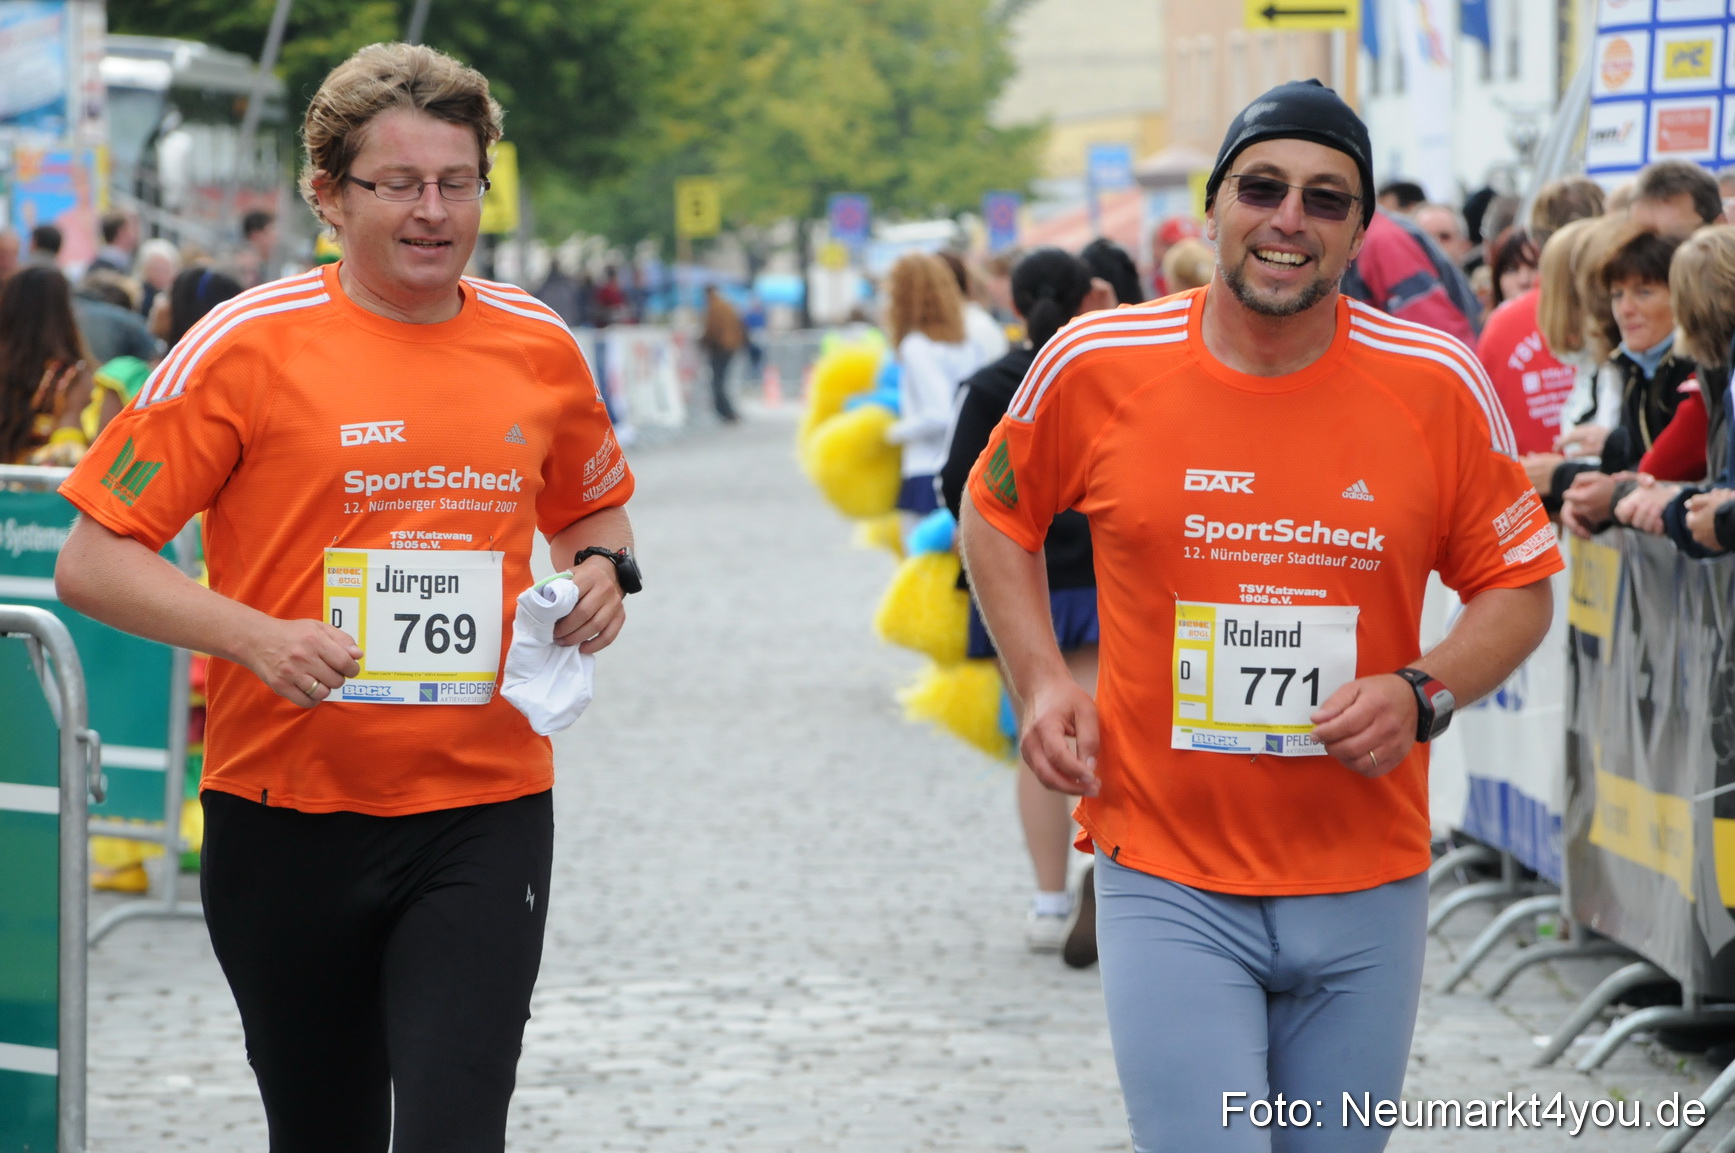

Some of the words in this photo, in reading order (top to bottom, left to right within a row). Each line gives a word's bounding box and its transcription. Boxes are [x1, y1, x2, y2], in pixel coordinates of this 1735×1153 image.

[340, 420, 407, 447] DAK
[504, 435, 527, 445] adidas
[344, 465, 523, 497] SportScheck
[1184, 469, 1255, 494] DAK
[1342, 490, 1374, 502] adidas
[343, 502, 364, 514] 12.
[369, 499, 436, 513] Nürnberger
[440, 498, 493, 512] Stadtlauf
[495, 501, 518, 513] 2007
[390, 531, 416, 540] TSV
[417, 531, 473, 542] Katzwang
[1184, 514, 1385, 552] SportScheck
[390, 541, 420, 549] 1905
[420, 541, 441, 550] e.V.
[1183, 546, 1205, 559] 12.
[1211, 548, 1284, 566] Nürnberger
[1287, 552, 1348, 567] Stadtlauf
[1350, 557, 1381, 571] 2007
[376, 565, 459, 599] Jürgen
[1239, 584, 1265, 594] TSV
[1266, 585, 1327, 598] Katzwang
[1240, 594, 1270, 604] 1905
[1272, 595, 1293, 605] e.V.
[332, 609, 342, 628] D
[394, 613, 476, 654] 769
[1224, 619, 1301, 648] Roland
[1181, 661, 1190, 680] D
[342, 685, 391, 697] BOCK
[1240, 667, 1319, 706] 771
[1192, 734, 1238, 746] BOCK
